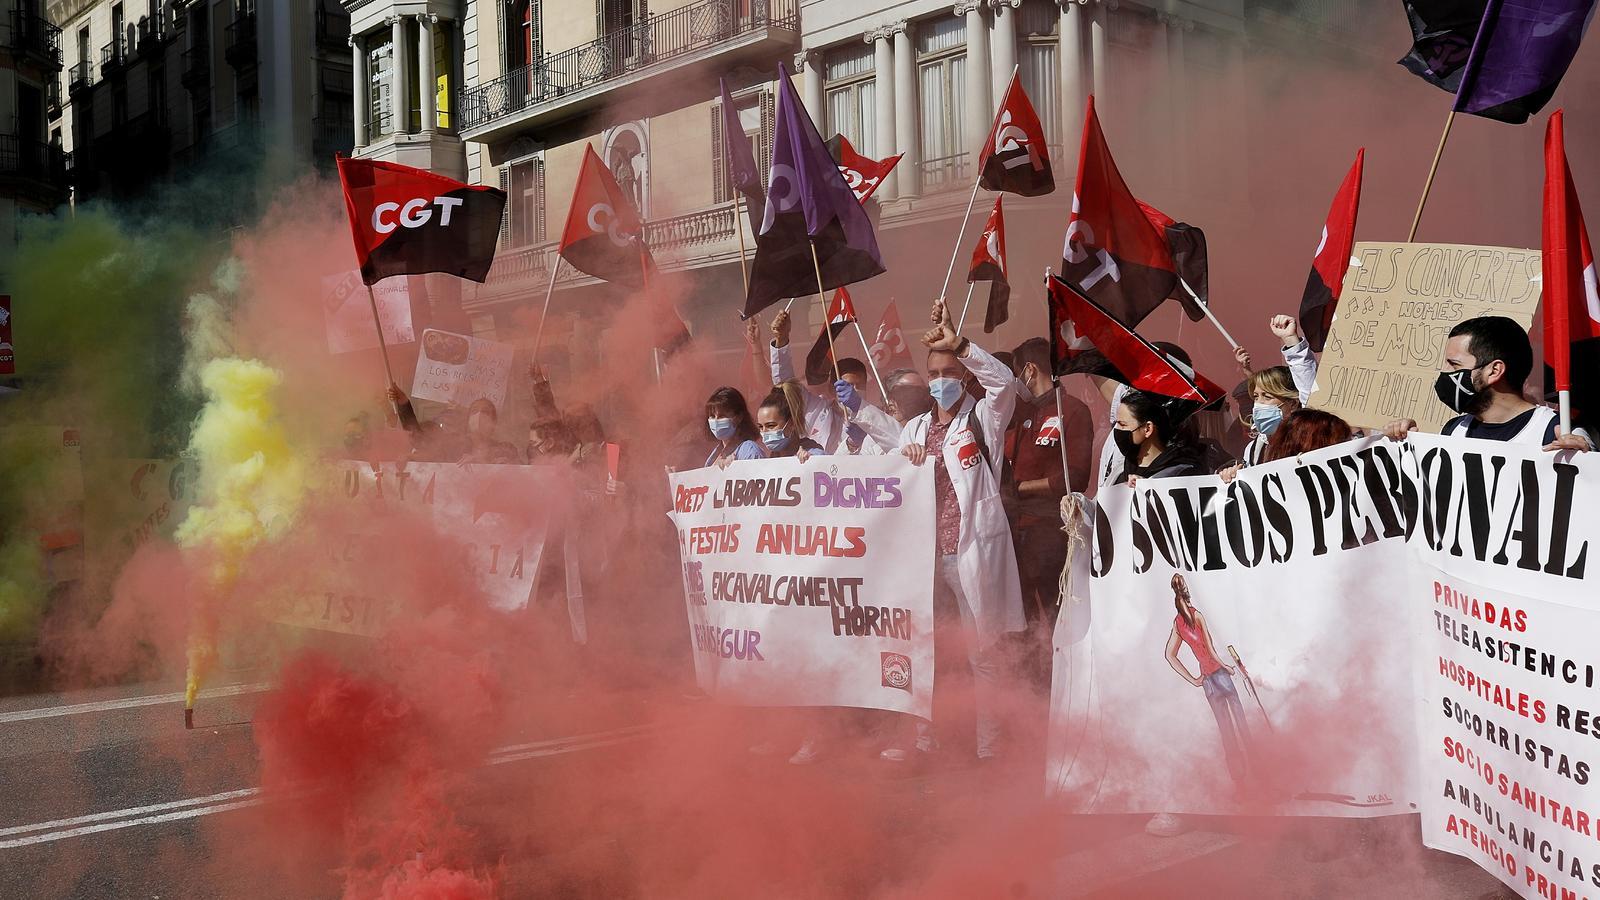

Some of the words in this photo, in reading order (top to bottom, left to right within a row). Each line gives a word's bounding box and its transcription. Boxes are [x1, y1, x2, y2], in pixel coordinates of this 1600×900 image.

[372, 196, 463, 234] CGT
[1352, 248, 1403, 293] ELS
[1405, 248, 1540, 304] CONCERTS
[1350, 320, 1378, 347] DE
[1035, 437, 1059, 447] CGT
[713, 477, 802, 509] LABORALS
[1131, 470, 1294, 575] SOMOS
[1295, 443, 1588, 580] PERSONAL
[755, 524, 867, 558] ANUALS
[712, 571, 864, 607] ENCAVALCAMENT
[1434, 581, 1527, 633] PRIVADAS
[830, 605, 912, 640] HORARI
[1434, 610, 1600, 688] TELEASISTENCI
[1439, 656, 1546, 724] HOSPITALES
[1557, 704, 1600, 740] RES
[1442, 697, 1590, 786] SOCORRISTAS
[1446, 814, 1517, 877] ATENCIO
[1525, 865, 1594, 900] PRIM
